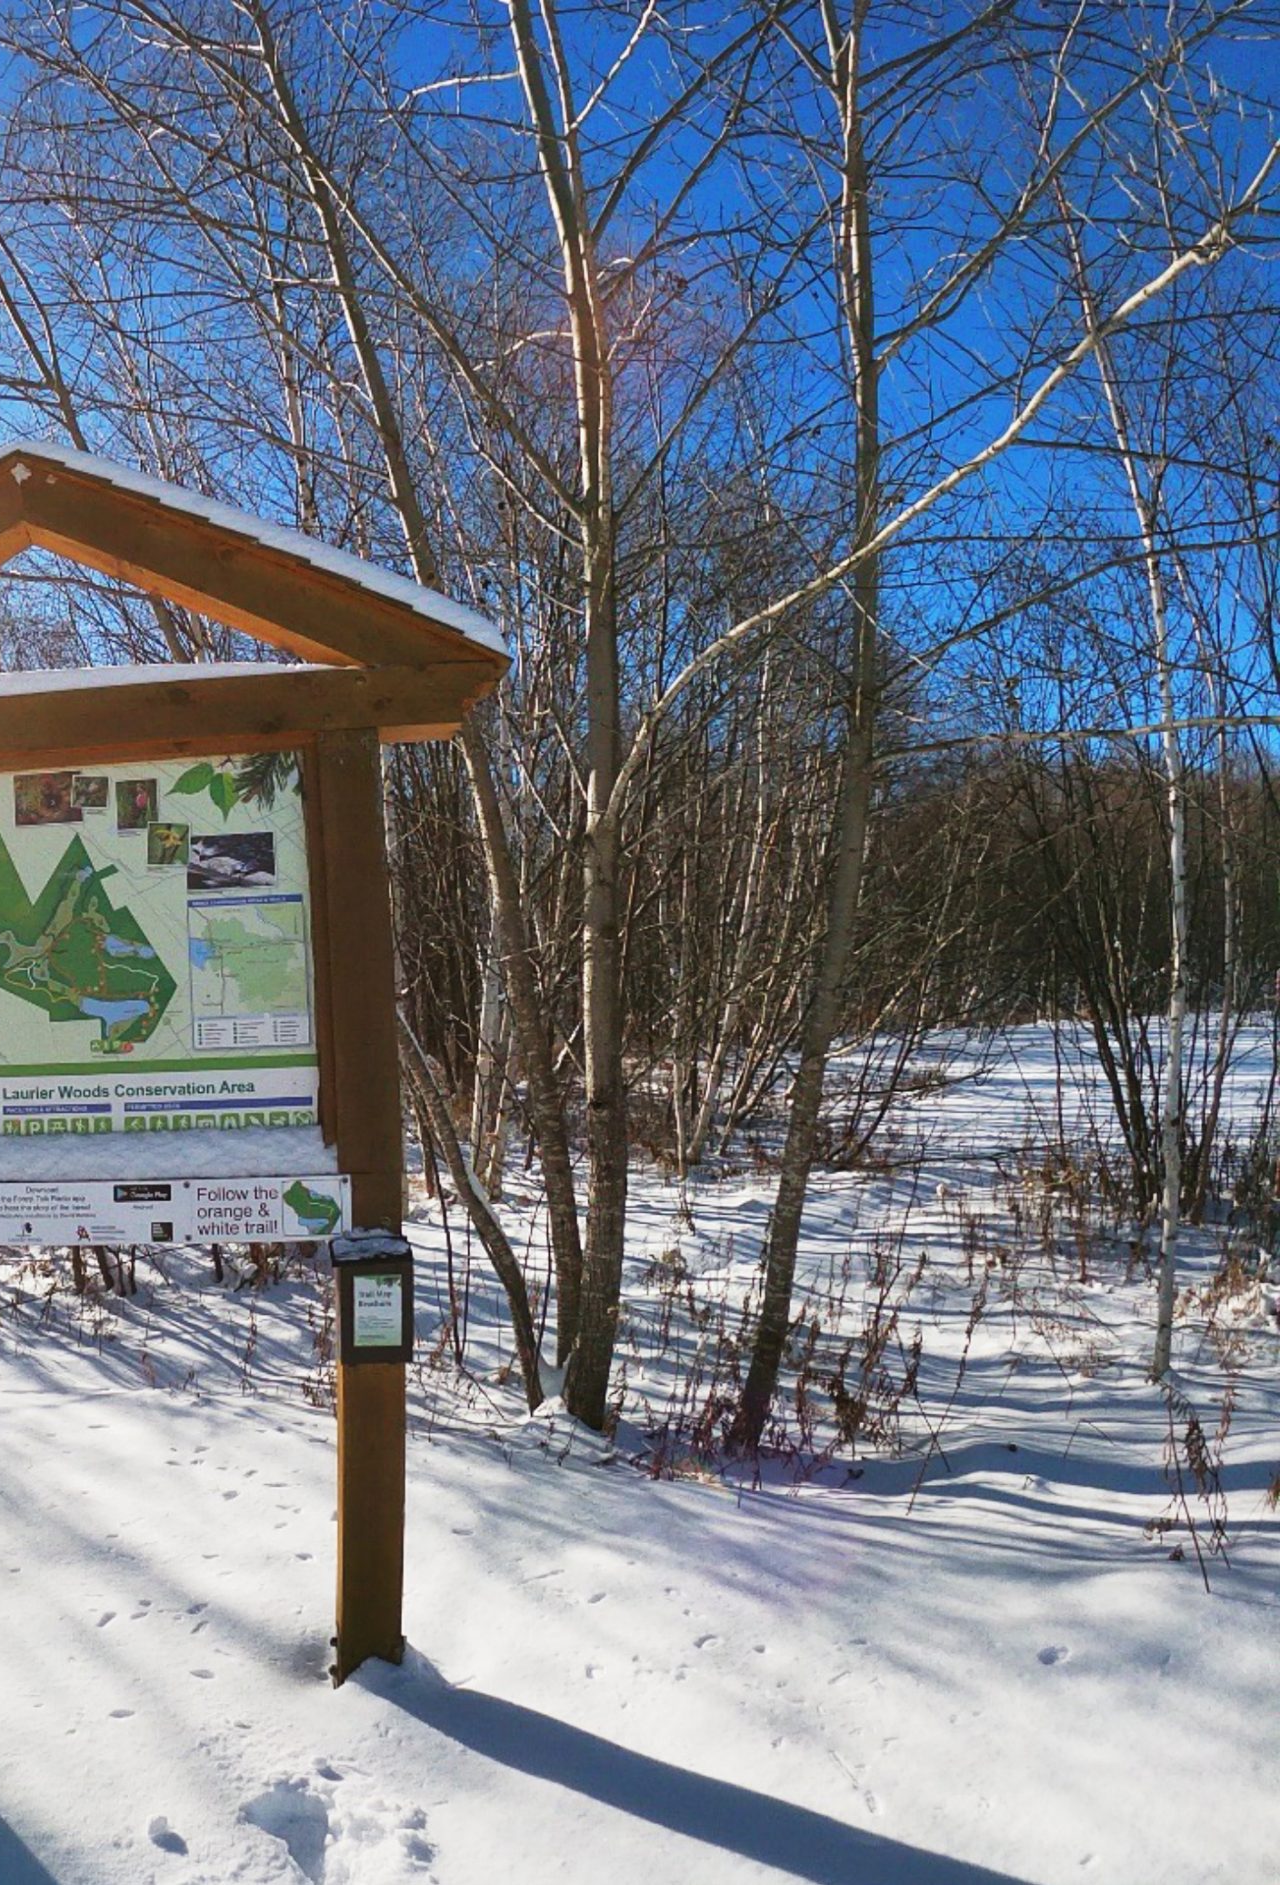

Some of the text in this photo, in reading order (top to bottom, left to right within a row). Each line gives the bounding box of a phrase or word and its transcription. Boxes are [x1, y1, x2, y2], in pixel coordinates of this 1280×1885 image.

[2, 1079, 256, 1100] Laurier Woods Conservation Area
[197, 1186, 279, 1202] Follow the
[197, 1203, 270, 1221] orange &
[197, 1220, 278, 1236] white trail!
